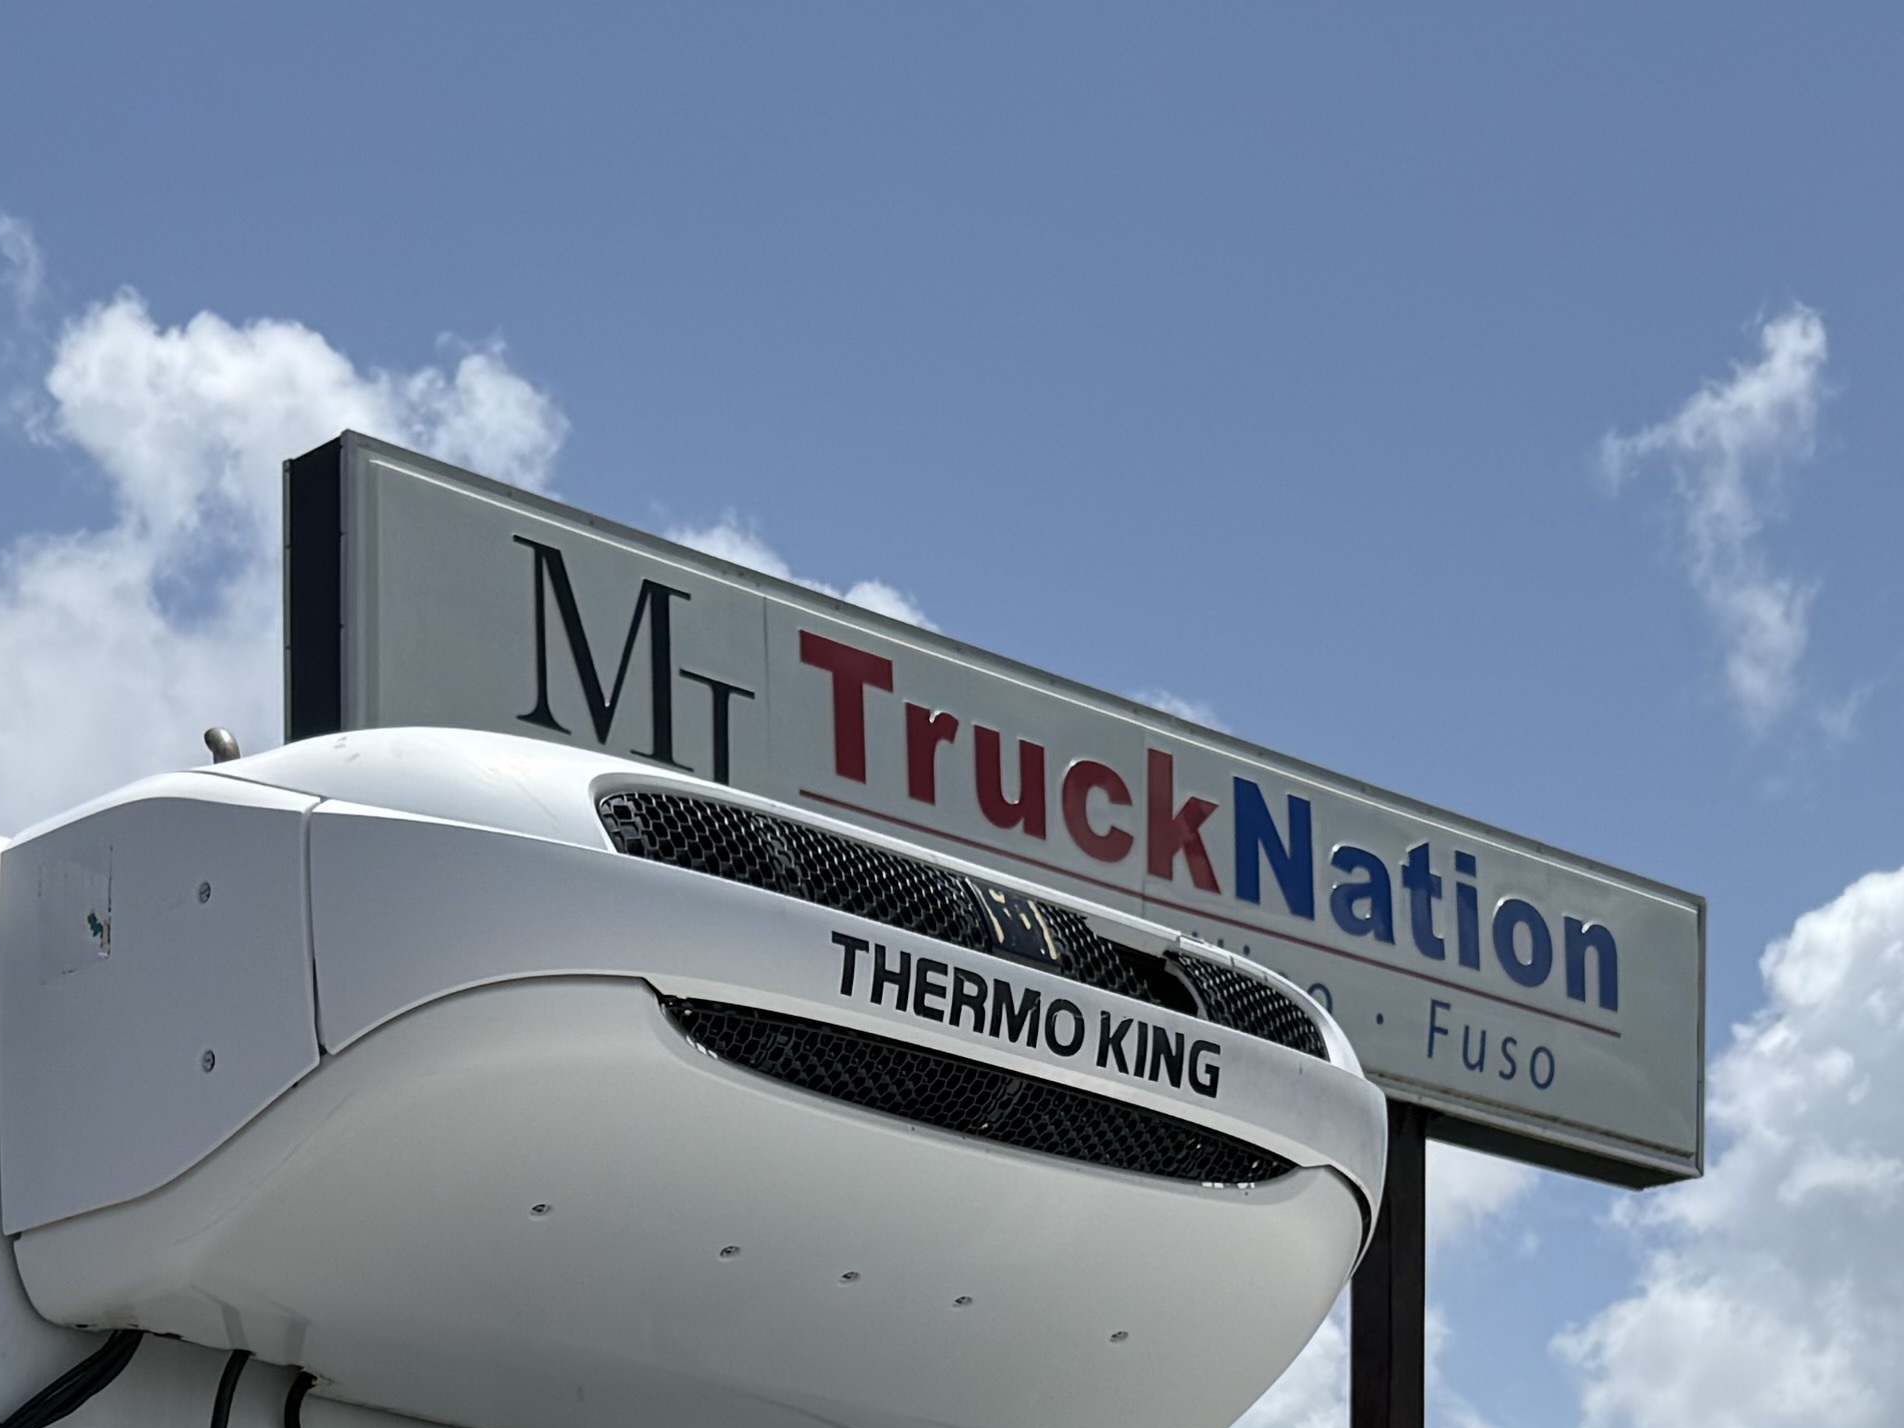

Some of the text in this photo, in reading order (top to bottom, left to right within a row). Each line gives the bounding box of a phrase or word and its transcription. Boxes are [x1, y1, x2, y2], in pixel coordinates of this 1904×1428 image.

[798, 629, 1619, 1012] TruckNation
[831, 931, 1086, 1057] THERMO
[1096, 1012, 1222, 1099] KING
[1426, 999, 1556, 1091] Fuso
